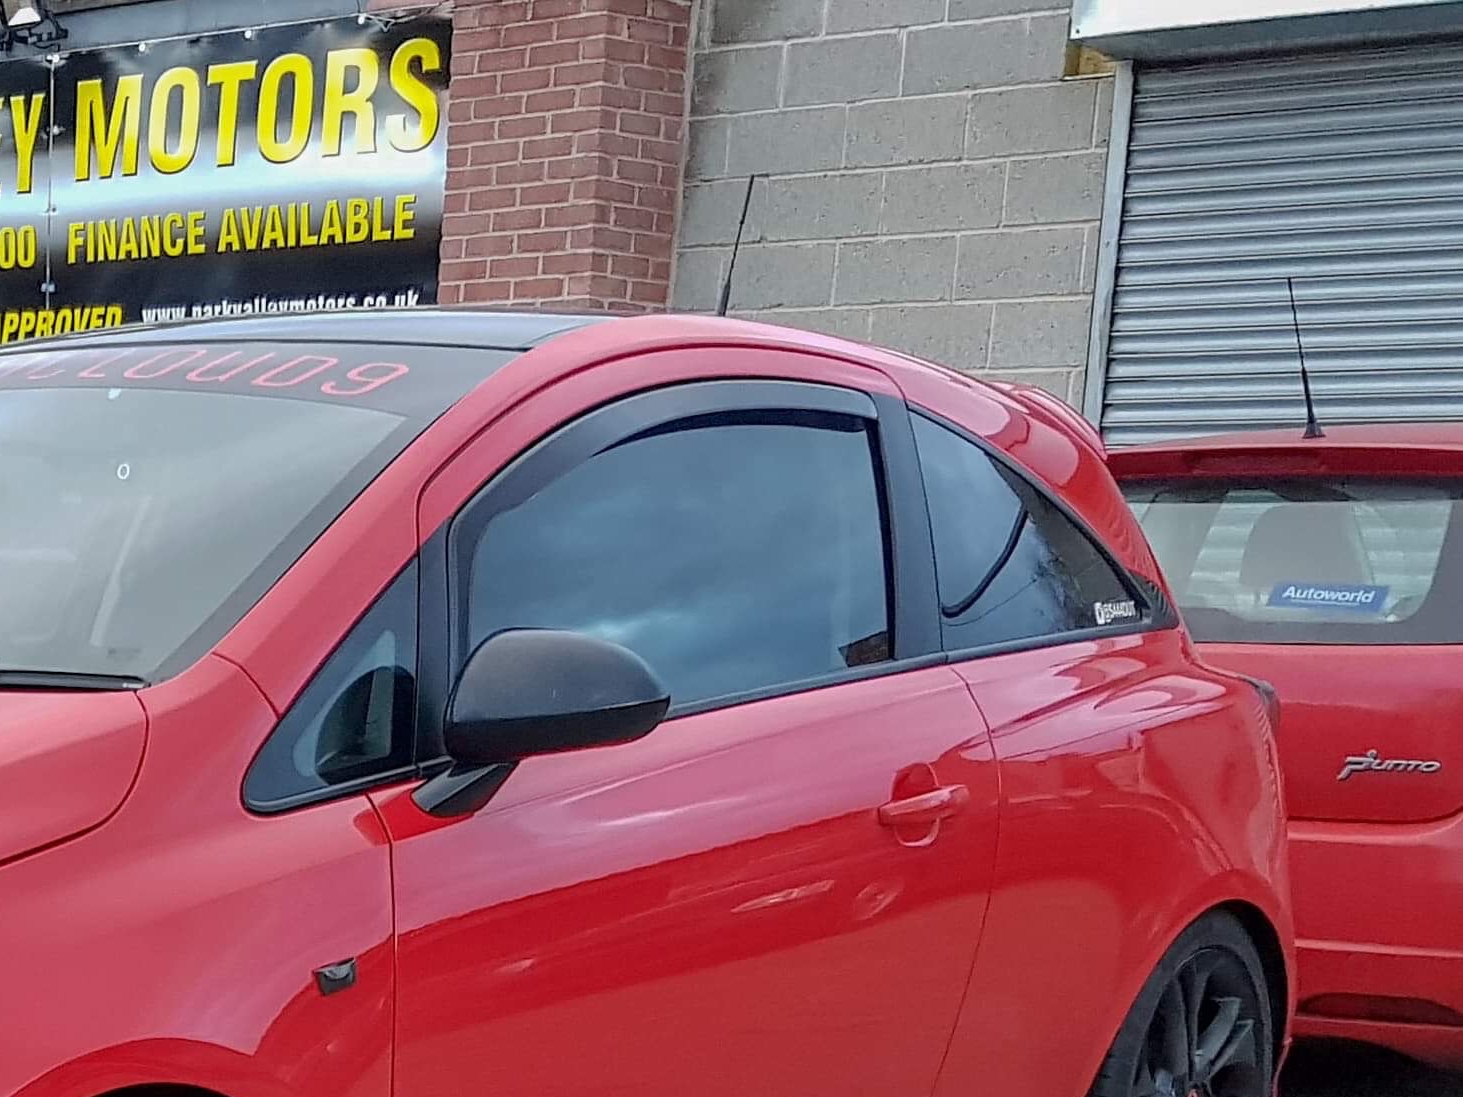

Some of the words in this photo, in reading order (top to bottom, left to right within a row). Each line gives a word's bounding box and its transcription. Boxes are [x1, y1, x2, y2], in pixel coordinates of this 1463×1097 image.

[73, 37, 442, 182] MOTORS
[67, 210, 207, 265] FINANCE
[217, 193, 417, 253] AVAILABLE
[141, 289, 419, 323] wwwparkvalleymotorscouk
[1282, 585, 1376, 604] Autoworld
